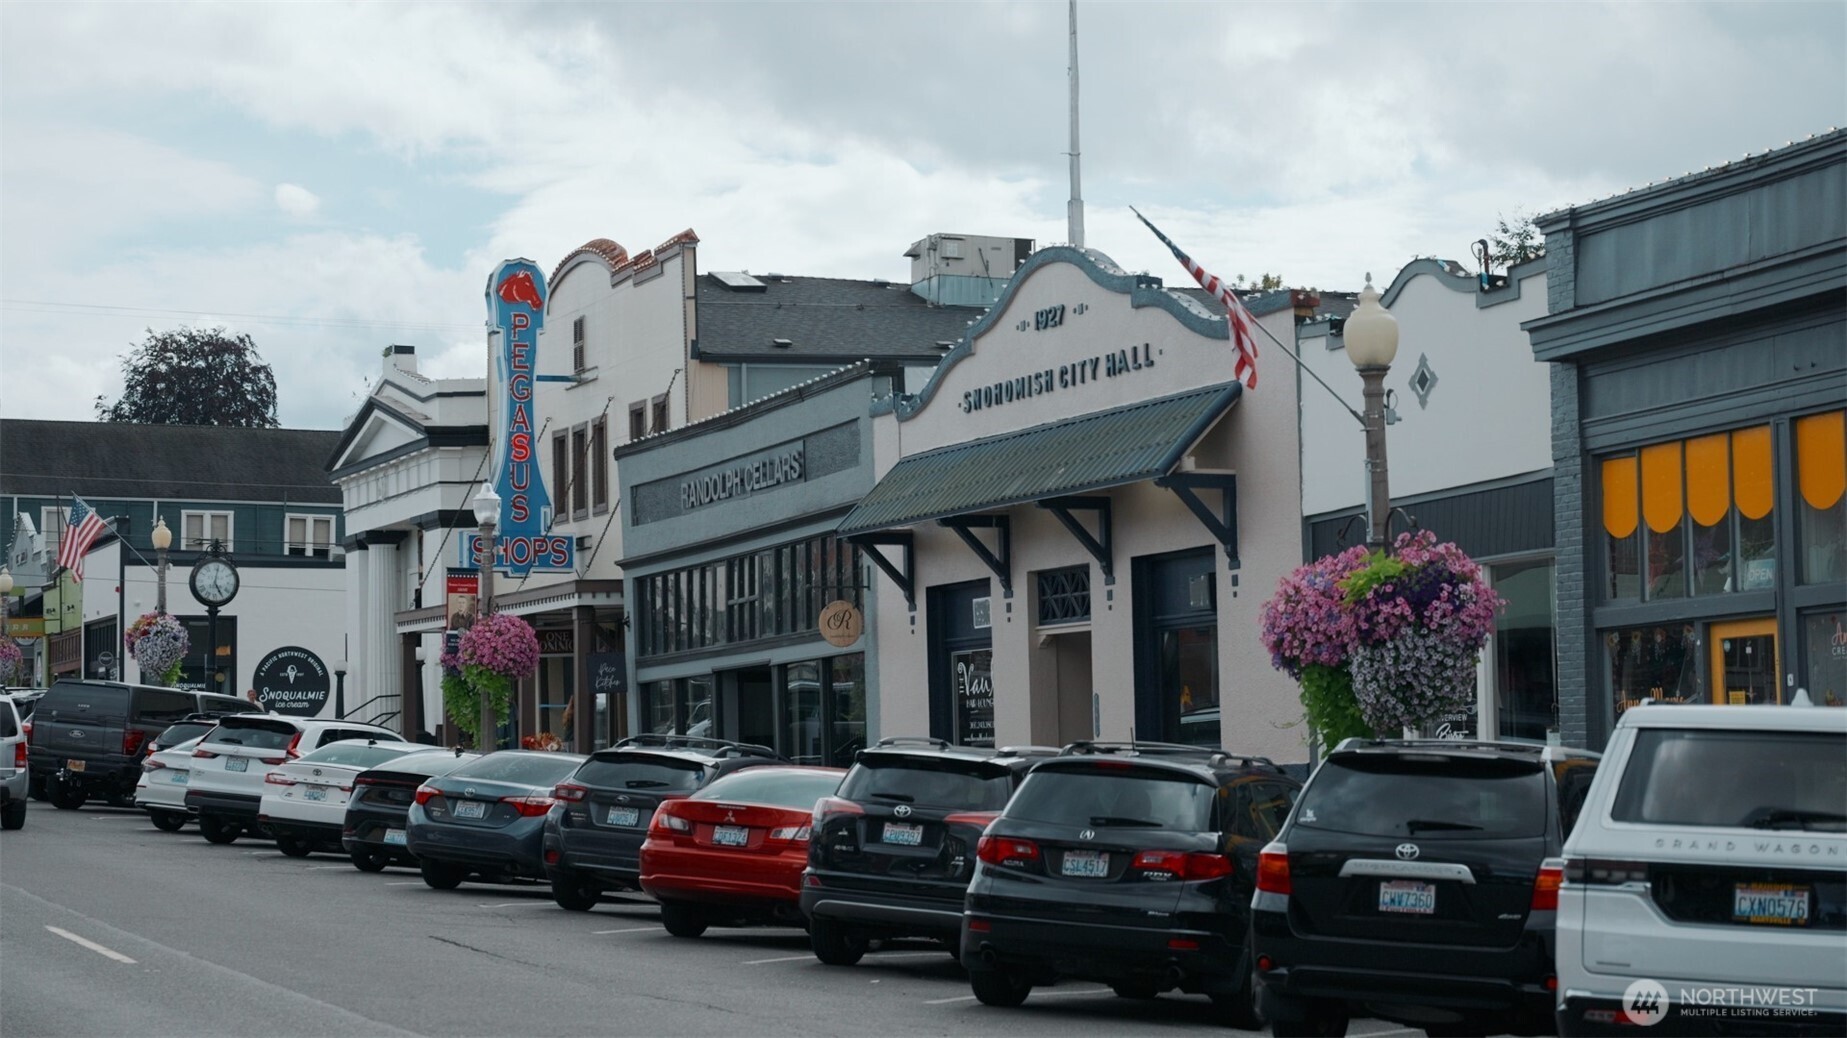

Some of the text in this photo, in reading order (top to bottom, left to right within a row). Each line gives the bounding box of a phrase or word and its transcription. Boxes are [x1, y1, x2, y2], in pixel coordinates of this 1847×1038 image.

[1034, 304, 1066, 331] 1927
[963, 342, 1155, 414] SNOHOMISH CITY HALL
[510, 312, 531, 523] PEGASUS
[680, 451, 800, 507] RANDOLPH CELLARS
[471, 535, 568, 566] SHOPS
[278, 650, 308, 659] NORTHWEST
[307, 656, 324, 677] ORIGINAL
[258, 686, 326, 703] SNOQUALMIE
[1655, 838, 1839, 856] GRAND WAGON
[1063, 858, 1107, 873] CSL4517
[1738, 896, 1806, 918] CXN0576
